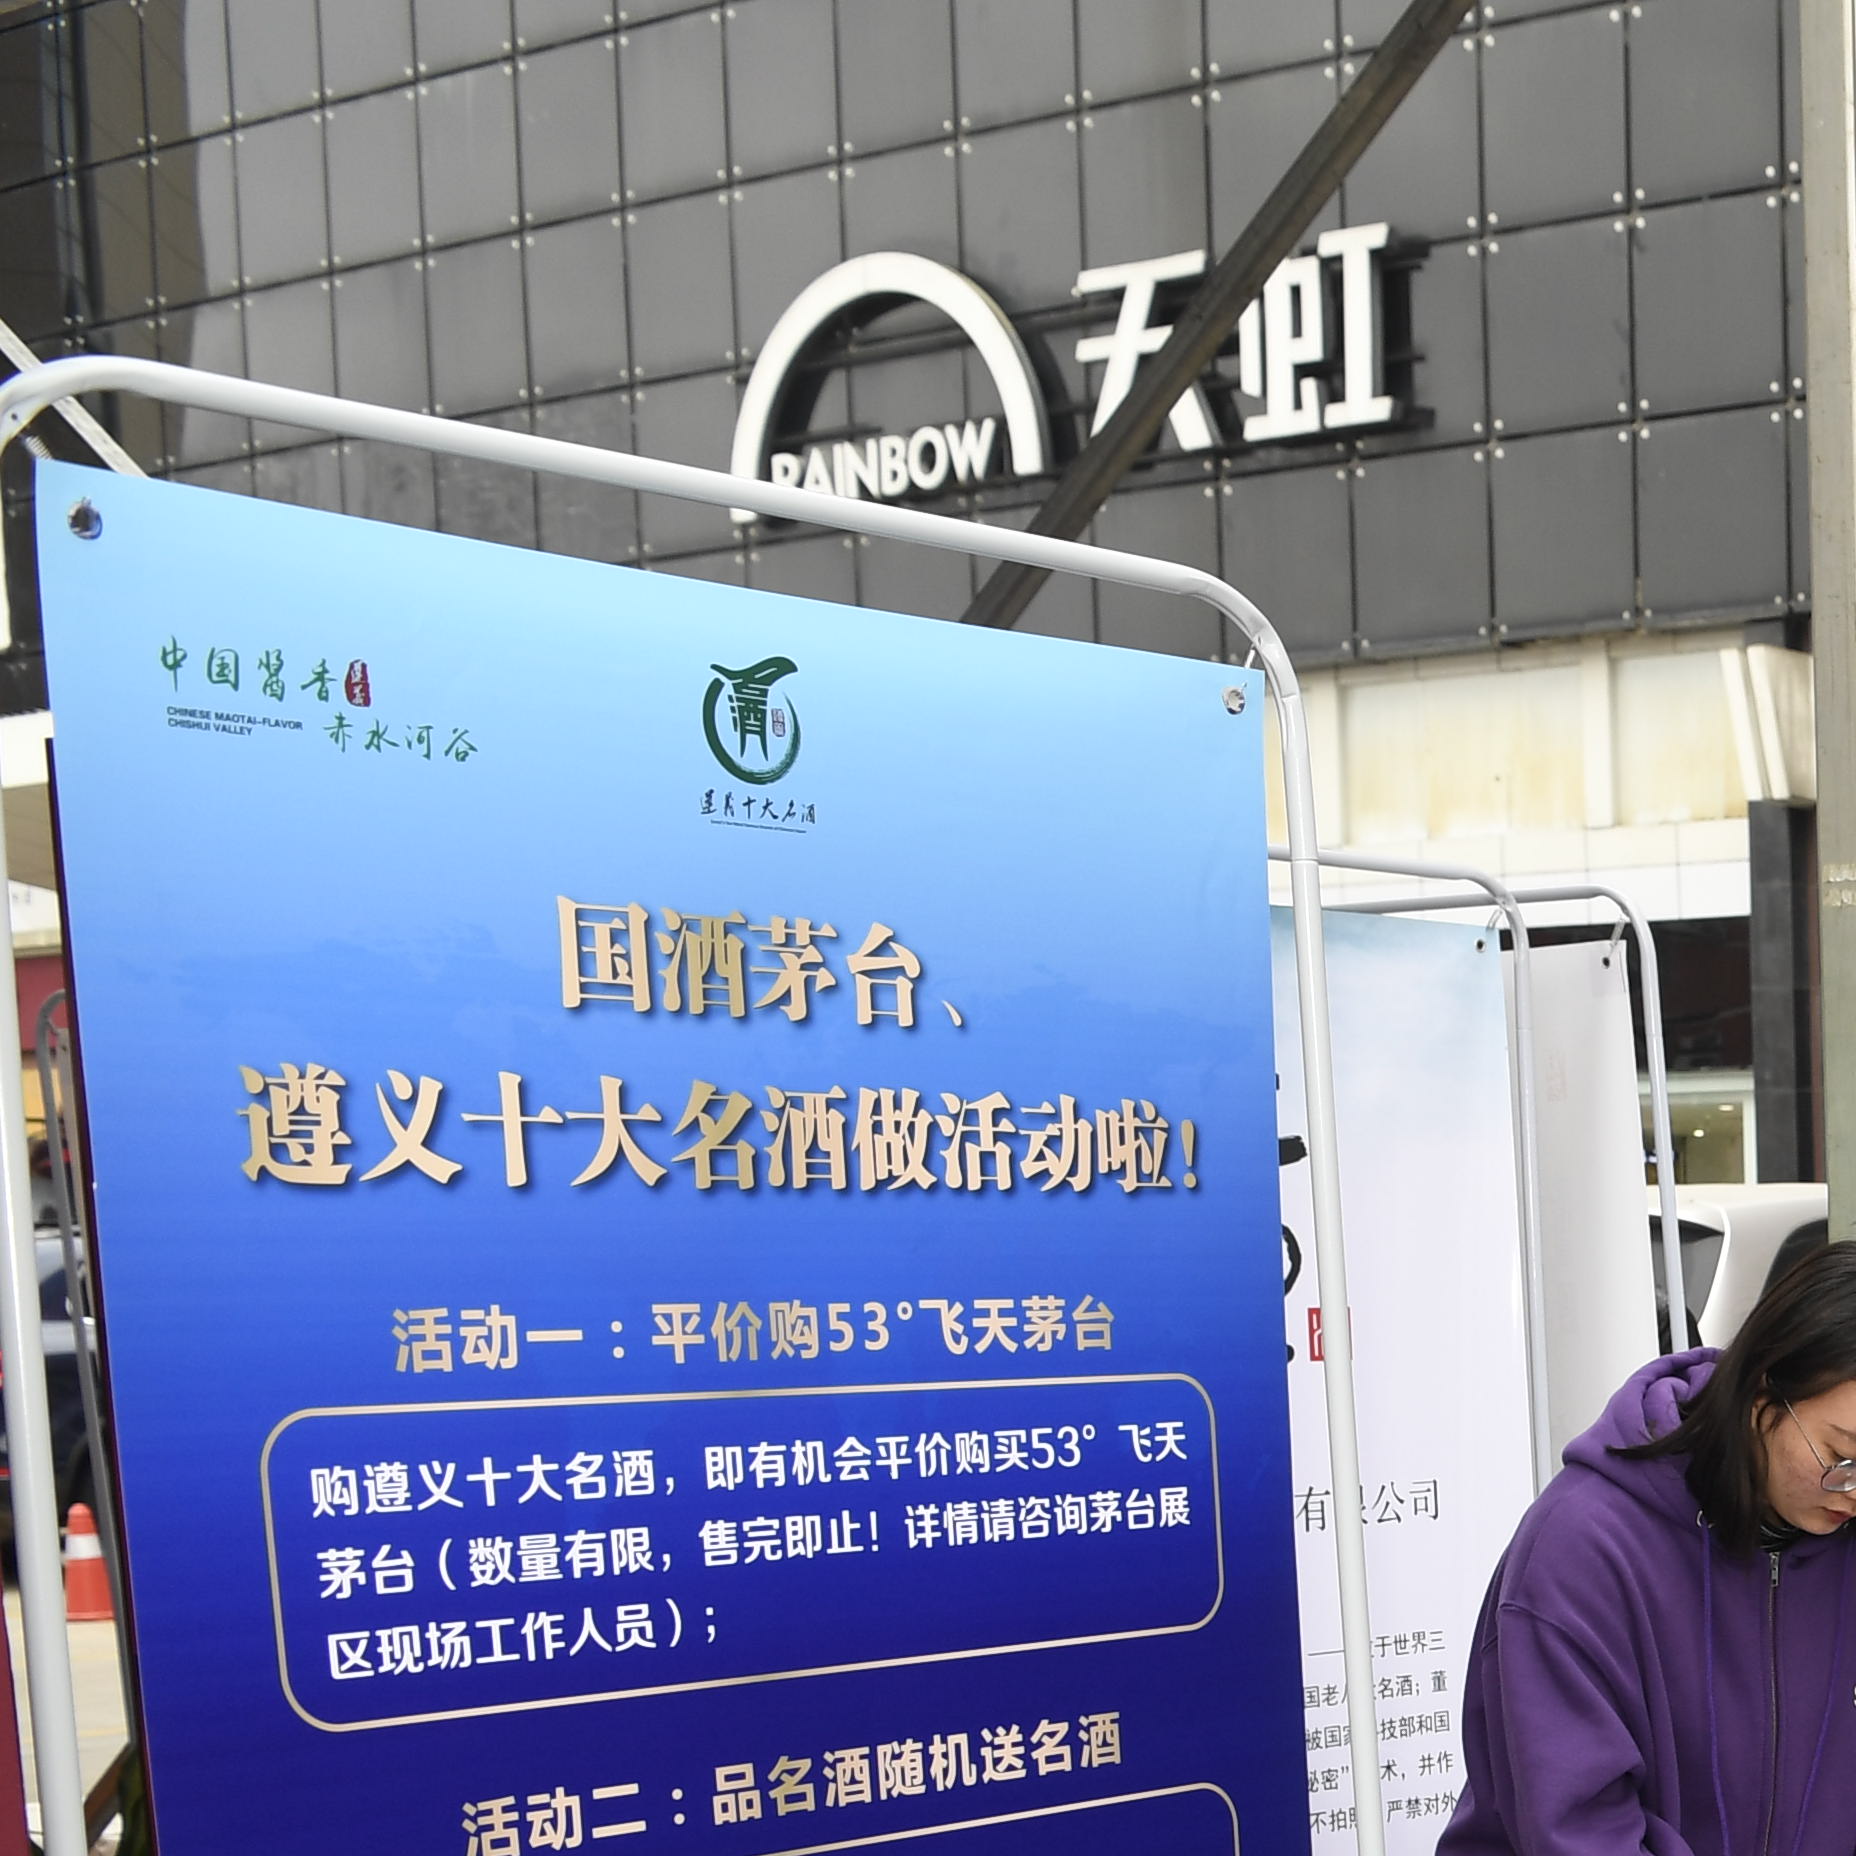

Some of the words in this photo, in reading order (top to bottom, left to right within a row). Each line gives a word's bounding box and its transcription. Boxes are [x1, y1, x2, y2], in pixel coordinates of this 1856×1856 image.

[771, 417, 996, 500] RAINBOW
[167, 706, 212, 720] CHINESE
[167, 718, 211, 732] CHISHUI
[213, 722, 253, 736] VALLEY
[556, 895, 964, 1029] 国酒茅台、
